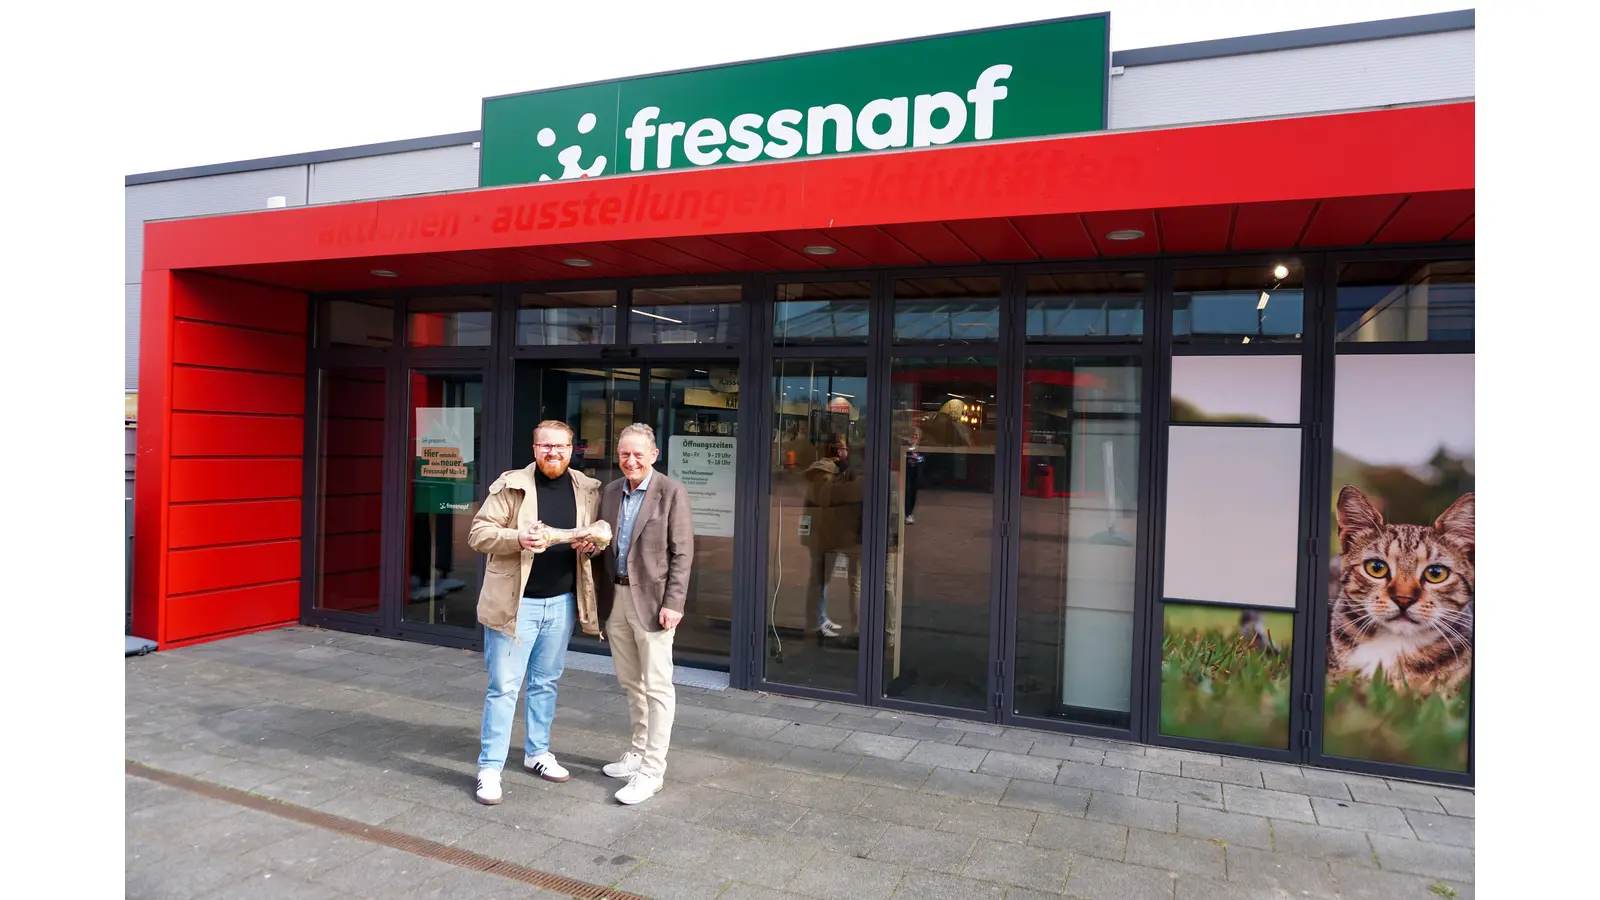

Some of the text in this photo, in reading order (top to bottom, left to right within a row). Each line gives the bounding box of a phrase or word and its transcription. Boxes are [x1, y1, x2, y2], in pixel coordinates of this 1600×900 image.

[625, 64, 1013, 172] fressnapf
[491, 178, 789, 235] ausstellungen
[682, 439, 733, 450] Öffnungszeiten
[424, 449, 439, 458] Hier
[423, 467, 449, 476] Fressnapf
